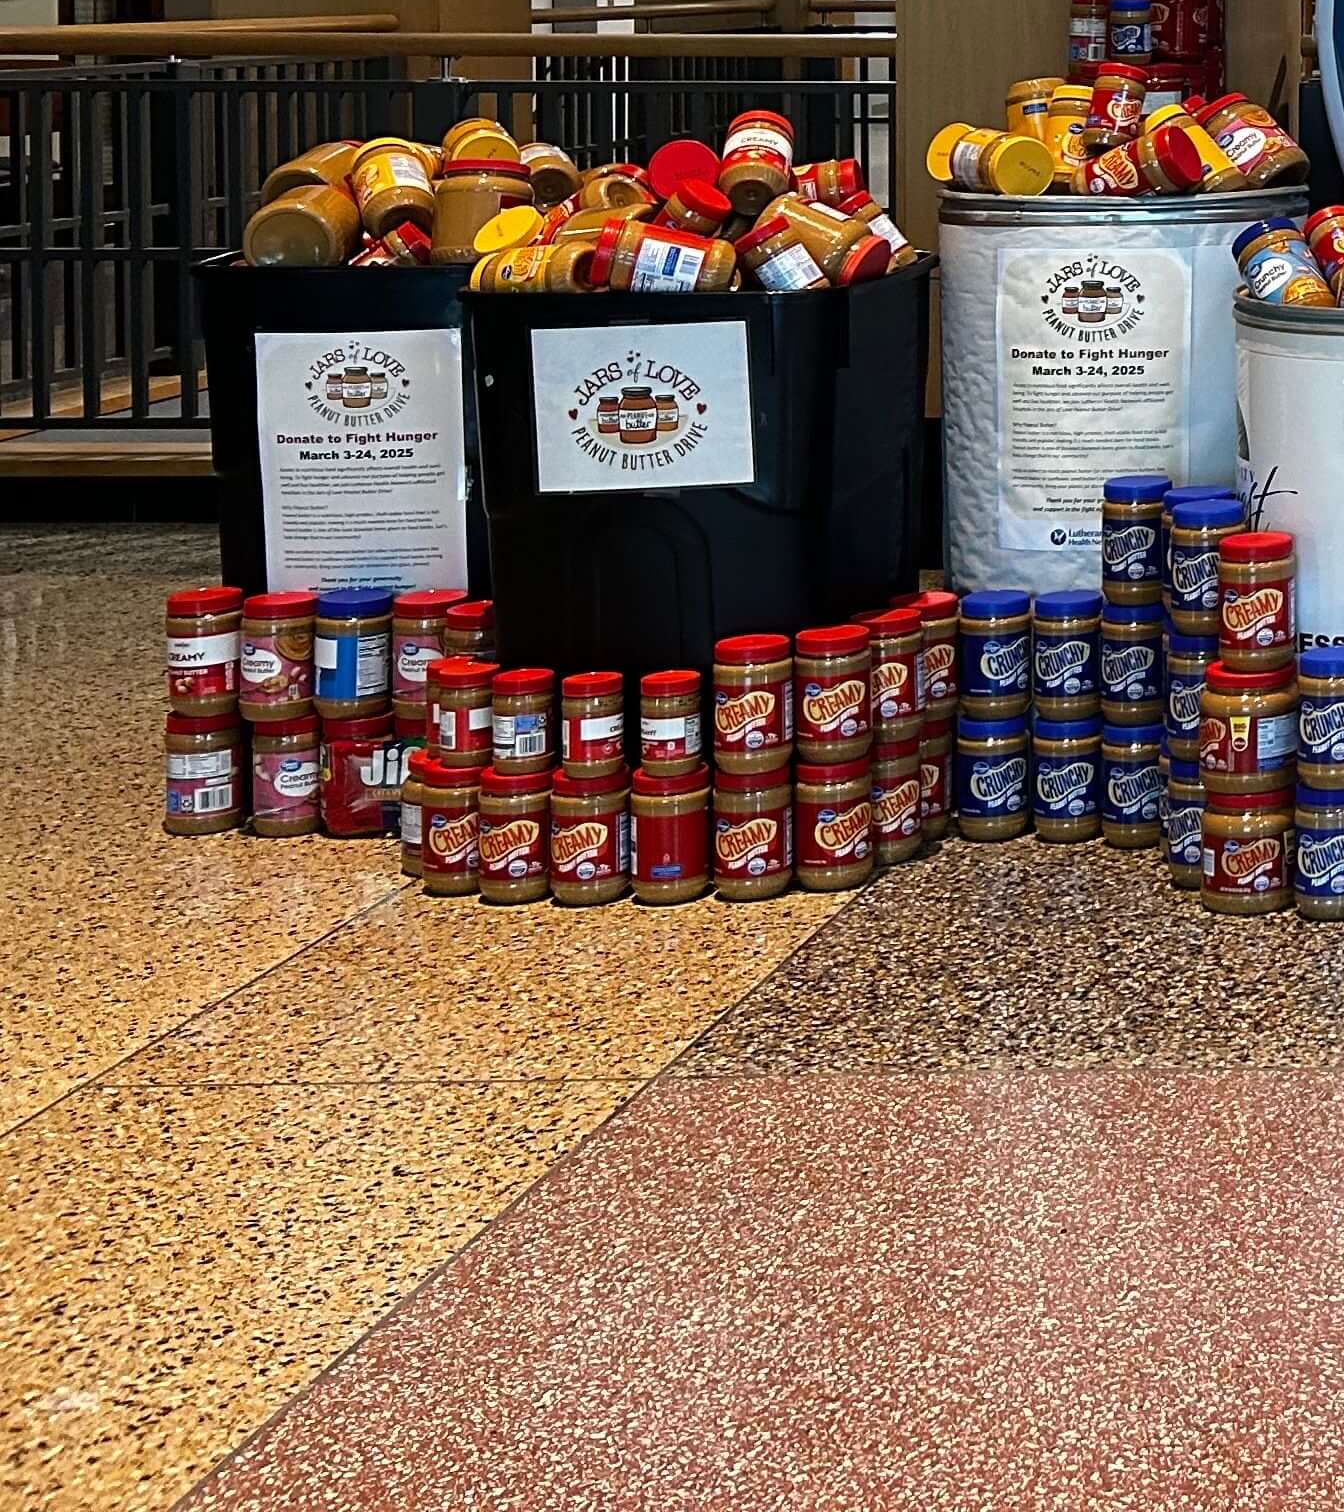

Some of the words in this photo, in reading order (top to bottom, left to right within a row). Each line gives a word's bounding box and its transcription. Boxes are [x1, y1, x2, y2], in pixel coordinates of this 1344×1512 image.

[740, 137, 779, 146] CREAMY
[1225, 131, 1258, 157] Creamy
[1048, 261, 1084, 294] JARS
[1100, 260, 1140, 292] LOVE
[1042, 309, 1076, 338] PEANUT
[1078, 328, 1117, 343] BUTTER
[1119, 309, 1145, 334] DRIVE
[308, 349, 345, 380] JARS
[362, 348, 405, 377] LOVE
[1011, 349, 1056, 359] Donate
[1061, 349, 1074, 359] to
[1079, 348, 1114, 360] Fight
[1119, 348, 1169, 360] Hunger
[574, 362, 623, 406] JARS
[627, 362, 641, 383] of
[644, 360, 700, 400] LOVE
[1032, 366, 1071, 376] March
[1076, 366, 1108, 377] 3-24,
[1112, 366, 1144, 376] 2025
[307, 395, 341, 424] PEANUT
[344, 413, 384, 427] BUTTER
[386, 393, 410, 417] DRIVE
[625, 420, 651, 429] butter
[277, 434, 323, 444] Donate
[328, 435, 341, 444] to
[346, 433, 382, 445] Fight
[386, 431, 438, 443] Hunger
[300, 450, 339, 460] March
[344, 450, 375, 460] 3-24,
[380, 448, 413, 458] 2025
[572, 426, 618, 466] PEANUT
[622, 449, 674, 470] BUTTER
[677, 423, 708, 456] DRIVE
[1104, 529, 1151, 565] CRUNCHY
[1226, 592, 1281, 628] CREAMY
[242, 657, 275, 669] Creamy
[480, 824, 534, 861] CREAMY
